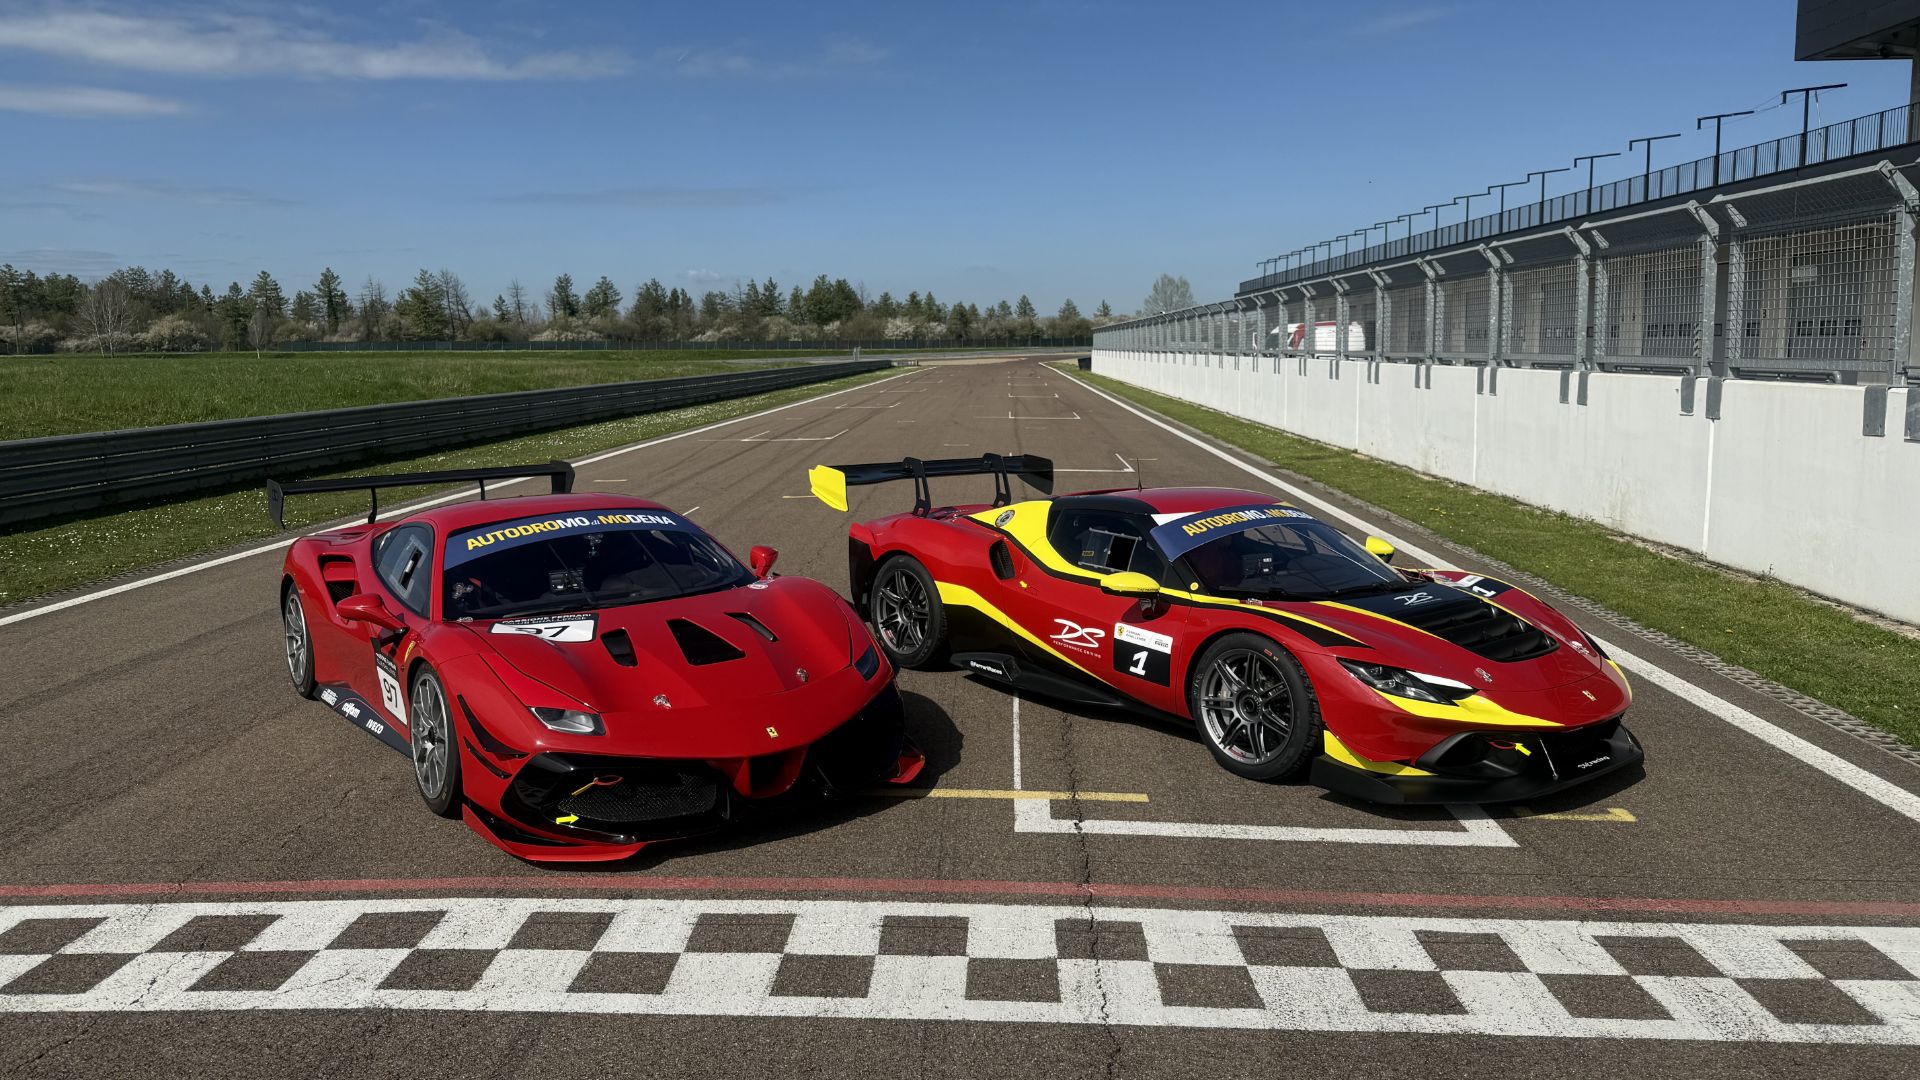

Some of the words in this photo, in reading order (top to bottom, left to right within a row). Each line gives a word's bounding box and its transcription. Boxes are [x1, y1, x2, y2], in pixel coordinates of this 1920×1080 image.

[466, 516, 591, 551] AUTODROMO
[598, 514, 677, 526] MODENA
[1182, 509, 1266, 537] AUTODROMO
[1050, 618, 1106, 648] DS
[1053, 640, 1083, 653] PERFORMANCE
[1129, 650, 1149, 676] 1
[382, 677, 398, 709] 97
[365, 718, 385, 735] IVECO
